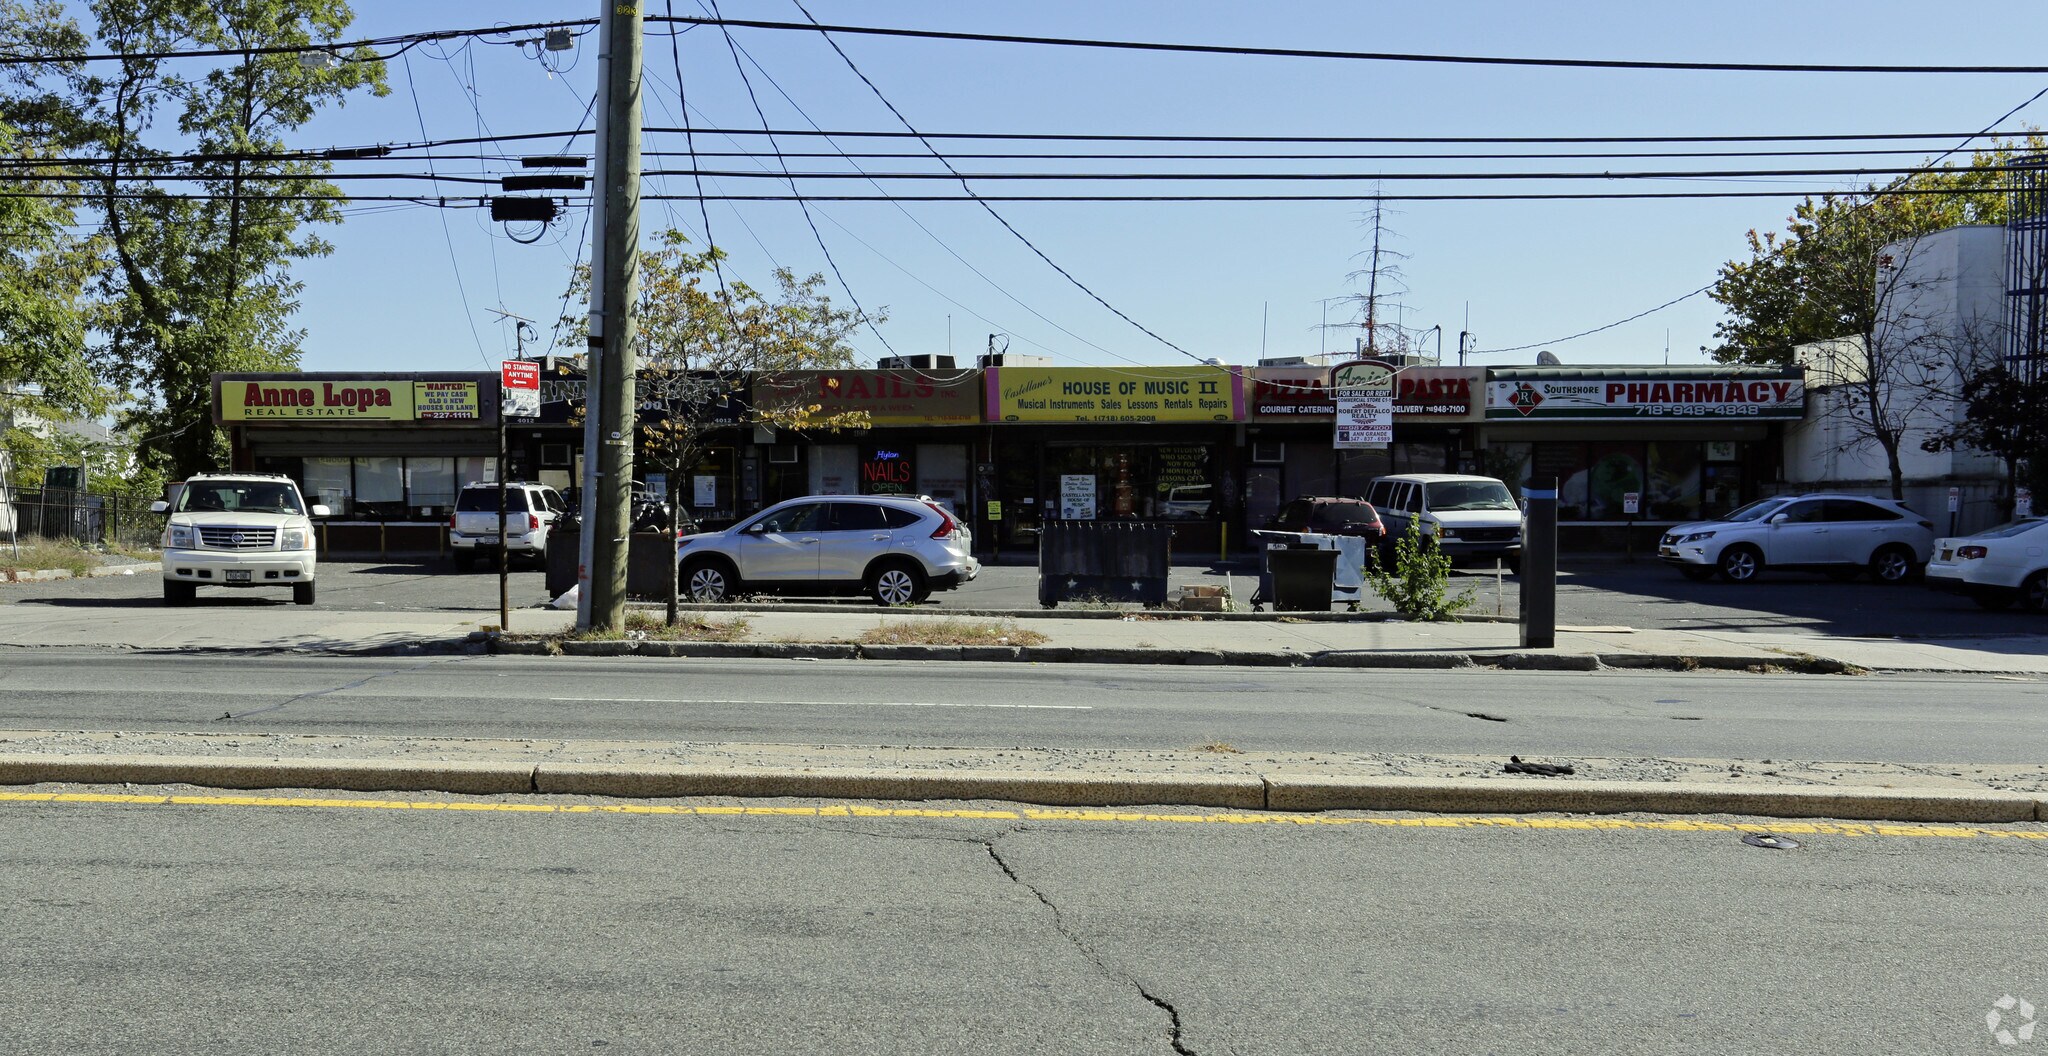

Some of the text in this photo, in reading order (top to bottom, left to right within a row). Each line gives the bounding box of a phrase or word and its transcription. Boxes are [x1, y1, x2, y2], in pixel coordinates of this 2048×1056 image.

[1338, 366, 1388, 386] Amici
[819, 374, 934, 399] NAILS
[1063, 381, 1218, 395] HOUSE OF MUSIC II
[1256, 379, 1324, 400] PIZZA
[1400, 378, 1470, 400] PASTA
[1544, 384, 1599, 394] SOUTHSHORE
[1606, 382, 1792, 403] PHARMACY
[244, 383, 392, 412] Anne Lopa
[1018, 398, 1227, 410] Musical Instruments Sales Lessons Rentals Repairs
[1634, 405, 1759, 415] 718-948-4848
[874, 451, 900, 460] Hylan
[864, 462, 910, 482] NAILS
[872, 483, 902, 492] OPEN
